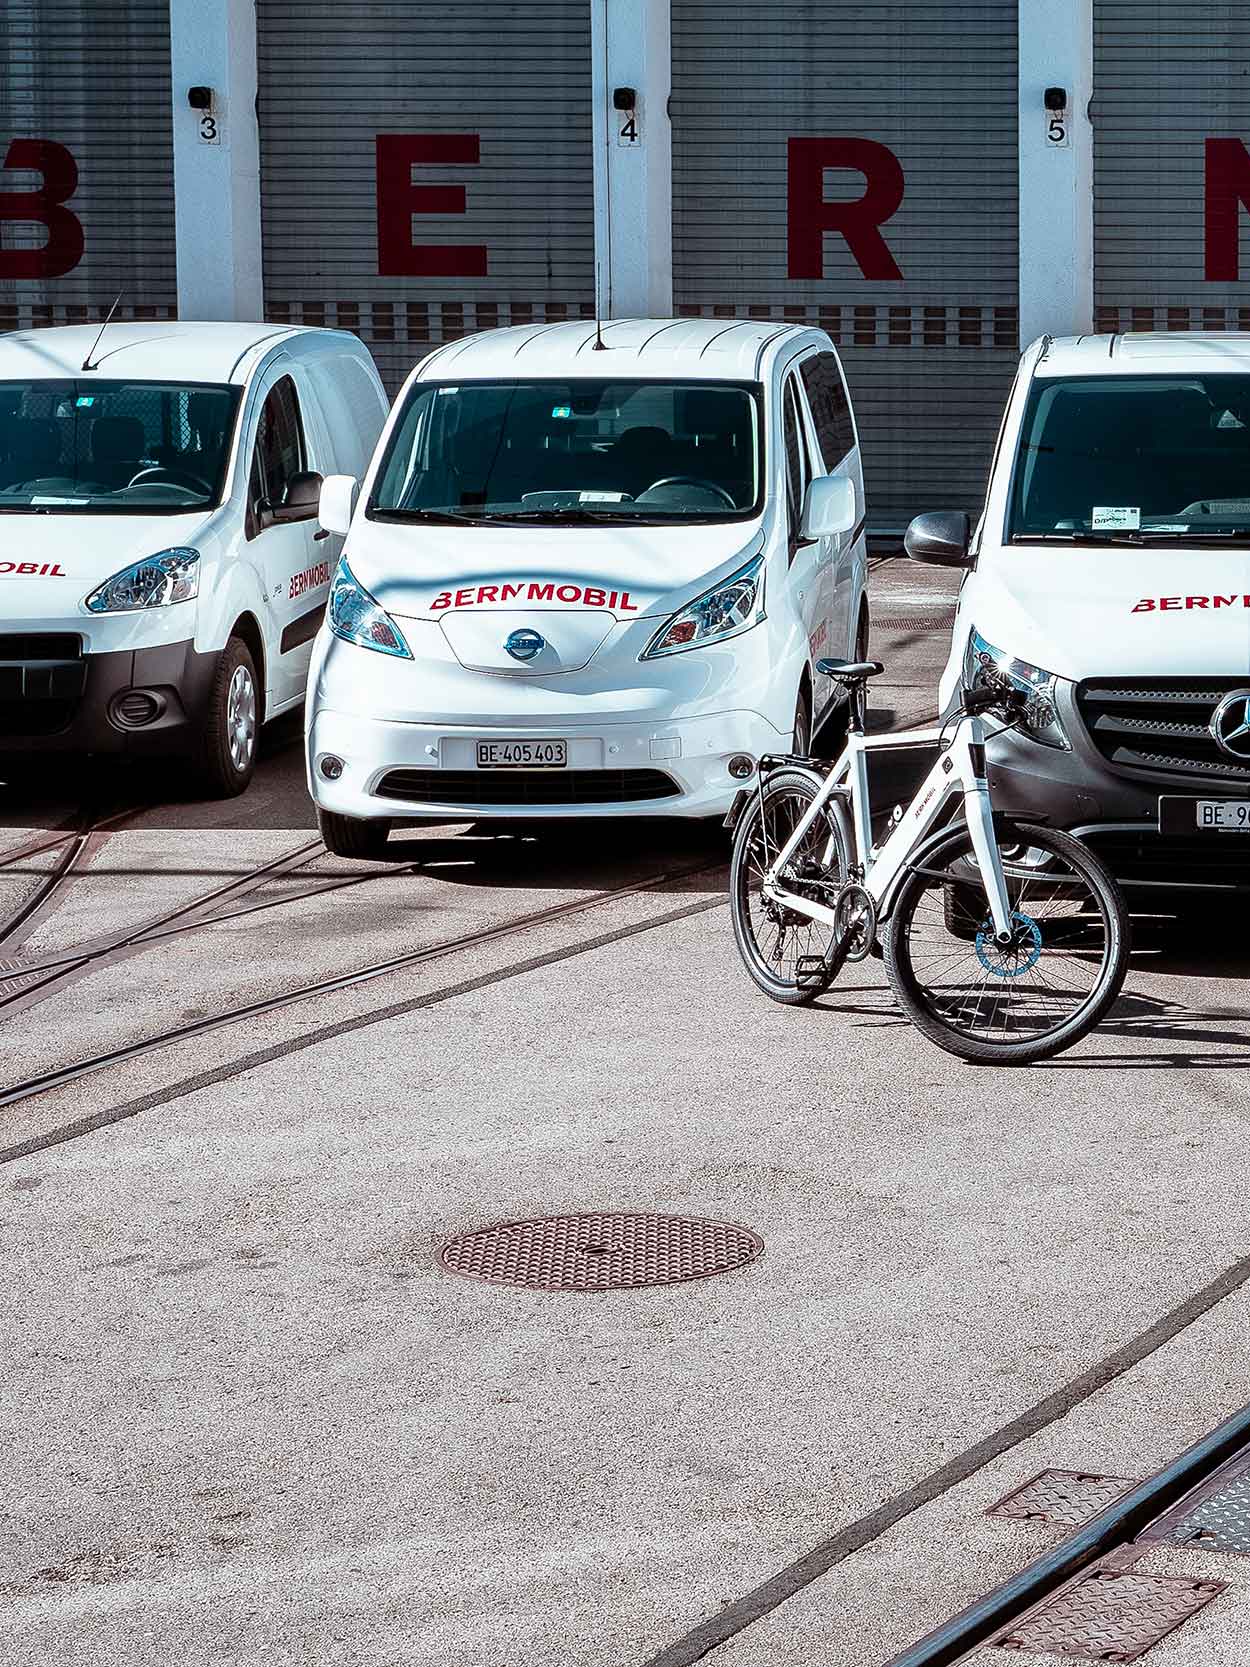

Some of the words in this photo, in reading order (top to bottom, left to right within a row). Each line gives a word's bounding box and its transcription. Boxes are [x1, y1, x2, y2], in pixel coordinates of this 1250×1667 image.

[200, 116, 217, 140] 3
[621, 119, 638, 142] 4
[1048, 119, 1065, 142] 5
[376, 134, 488, 276] E
[787, 137, 905, 280] R
[430, 583, 638, 611] BERNMOBIL
